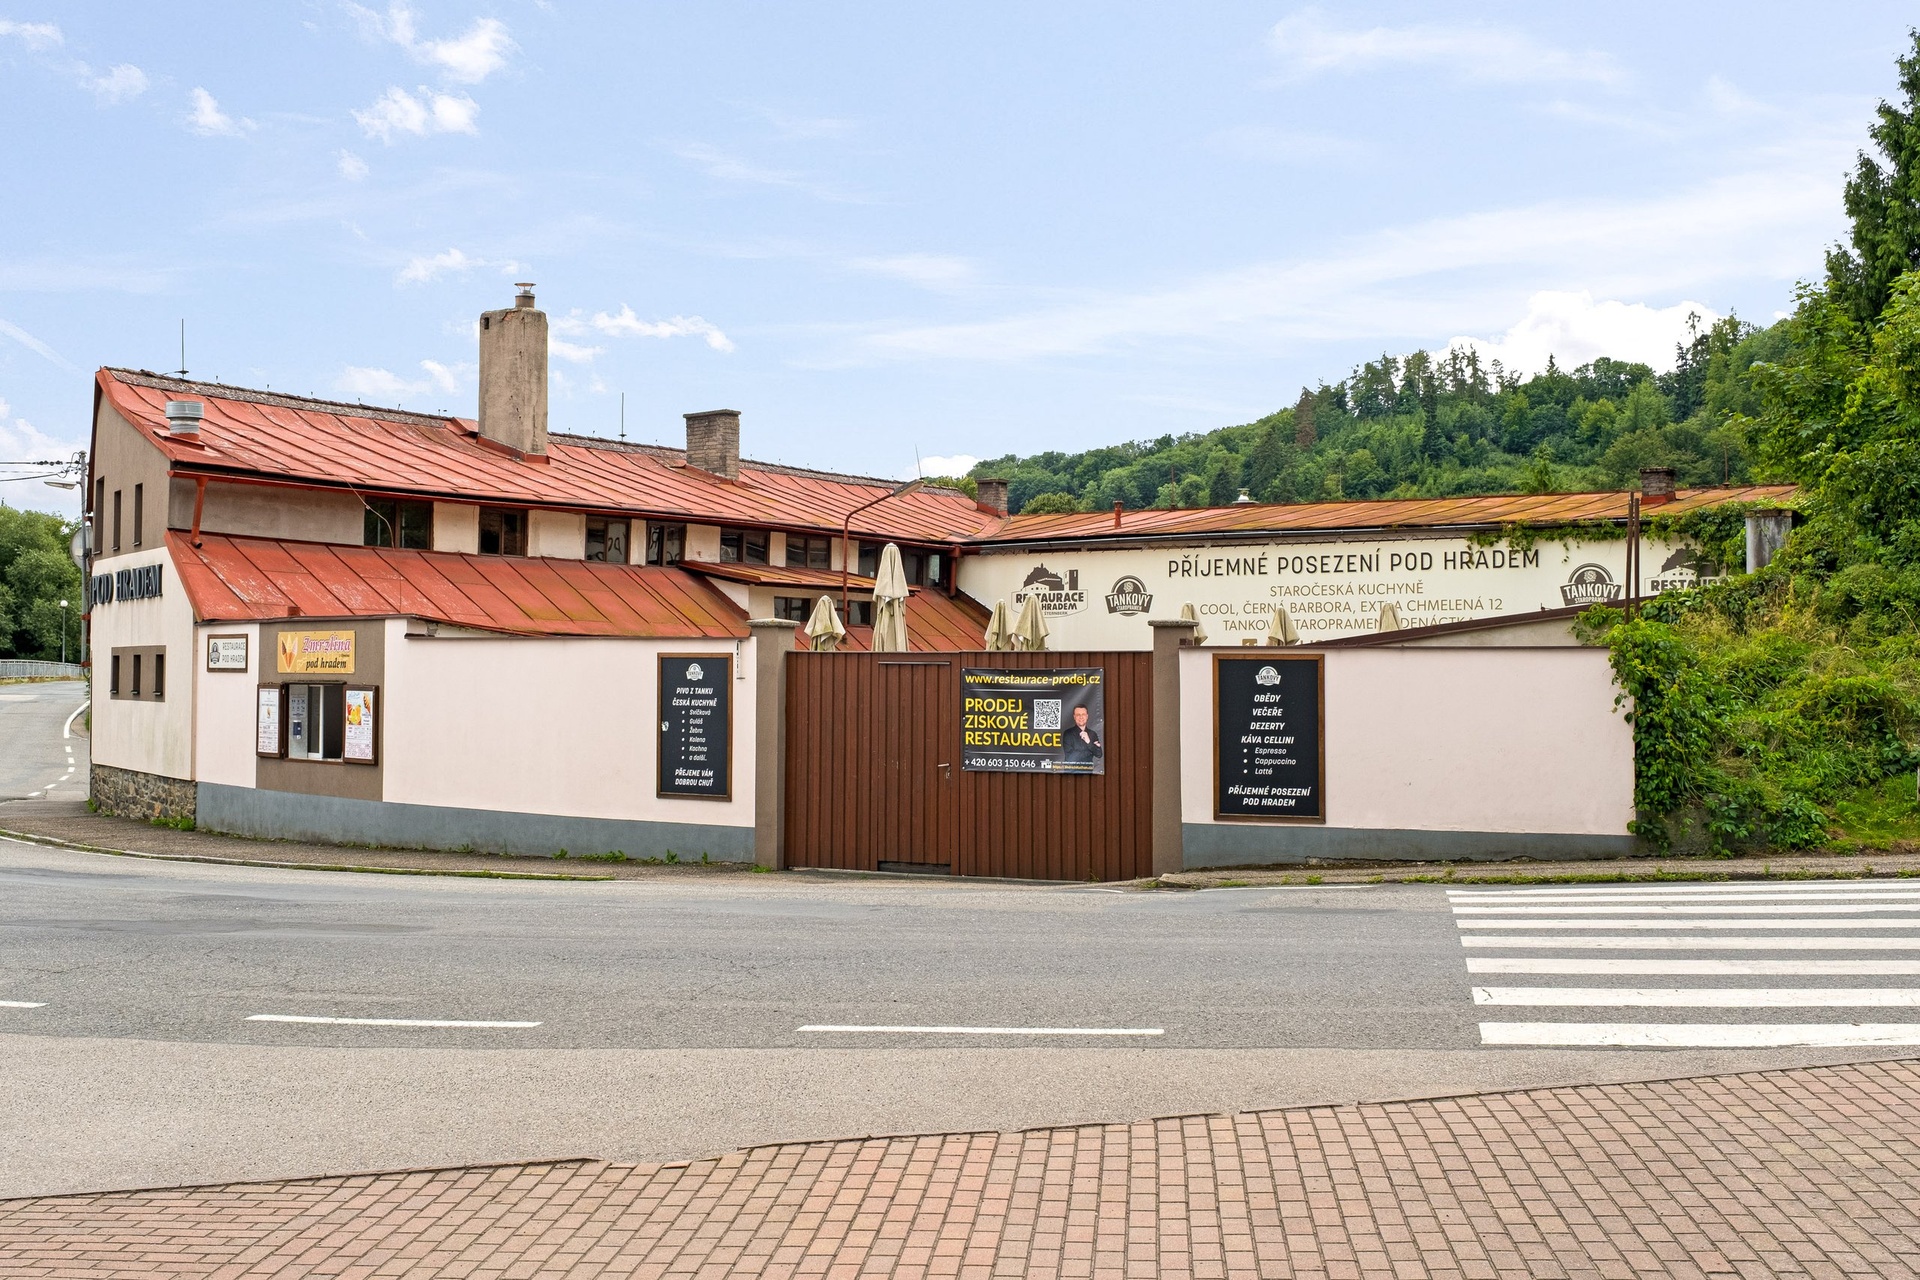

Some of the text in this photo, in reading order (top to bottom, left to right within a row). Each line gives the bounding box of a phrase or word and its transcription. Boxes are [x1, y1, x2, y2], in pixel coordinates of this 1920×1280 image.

[1168, 548, 1540, 578] PŘÍJEMNÉ POSEZENÍ POD HRADEM
[90, 564, 163, 605] POD HRADEM
[1270, 580, 1424, 597] STAROČESKÁ KUCHYNĚ
[1015, 591, 1085, 603] RETAURACE
[1041, 602, 1078, 611] HRADEM
[1200, 603, 1239, 616] COOL,
[1290, 601, 1356, 614] BARBORA,
[1360, 600, 1403, 613] EXTA
[1406, 596, 1484, 612] CHMELENÁ
[1489, 598, 1503, 611] 12
[1223, 619, 1270, 631] TANKO
[1291, 617, 1379, 631] TAROPRAME
[302, 634, 352, 654] Zmrzlina
[305, 657, 347, 671] pod hradem
[965, 673, 1101, 686] www.restaurace-prodej.cz
[676, 687, 714, 695] PIVO Z TANKU
[672, 697, 717, 707] ČESKÁ KUCHYNĚ
[1254, 692, 1281, 703] OBĚDY
[965, 698, 1023, 713] PRODEJ
[1252, 706, 1283, 716] VEČEŘE
[964, 713, 1029, 730] ZISKOVÉ
[1250, 722, 1285, 730] DEZERTY
[965, 731, 1062, 747] RESTAURACE
[1241, 734, 1295, 744] KÁVA CELLINI
[1254, 747, 1287, 756] Espresso
[987, 758, 1003, 767] 603
[1004, 759, 1019, 768] 150
[1020, 759, 1036, 769] 646
[1254, 757, 1297, 766] Cappuccino
[675, 767, 714, 777] PŘEJEME VÁM
[674, 778, 714, 787] DOBROU CHUŤ
[1228, 784, 1311, 797] PŘÍJEMNÉ POSEZENÍ
[1242, 798, 1296, 807] POD HRADEM
